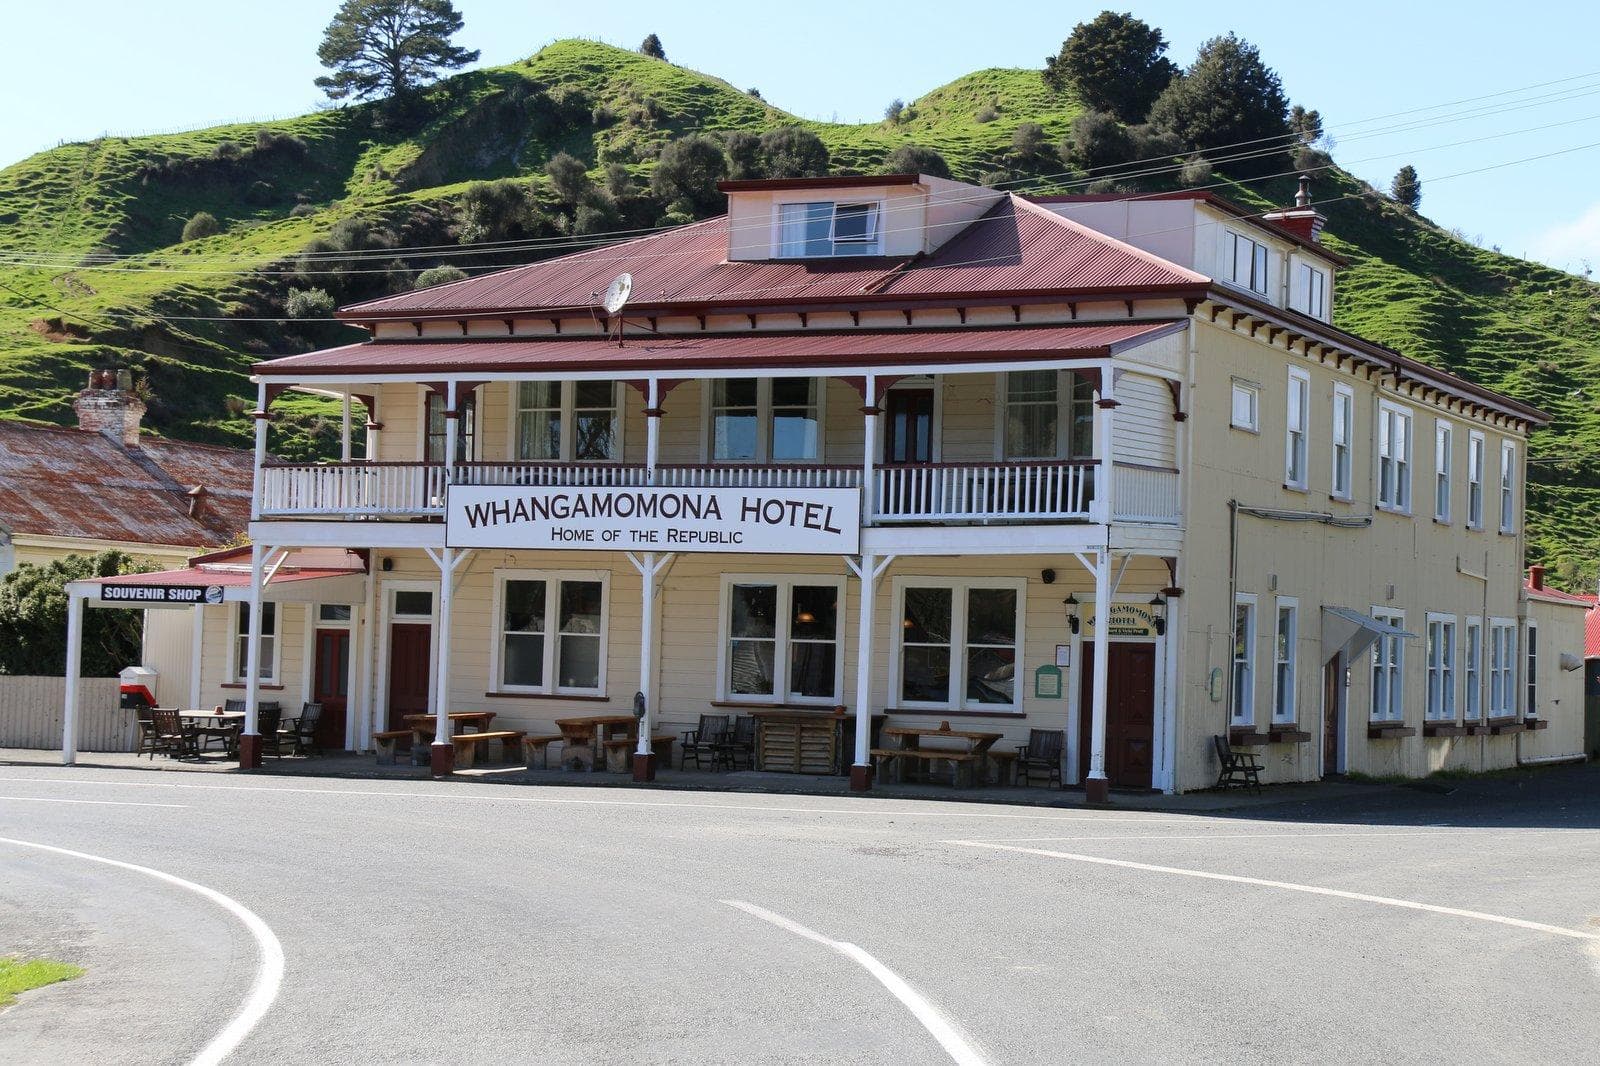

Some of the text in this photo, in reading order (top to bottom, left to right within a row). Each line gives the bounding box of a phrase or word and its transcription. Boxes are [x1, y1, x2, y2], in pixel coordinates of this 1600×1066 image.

[464, 493, 841, 535] WHANGAMOMONA HOTEL
[602, 529, 621, 542] OF
[630, 530, 658, 543] THE
[104, 587, 165, 600] SOUVENIR
[168, 588, 202, 601] SHOP
